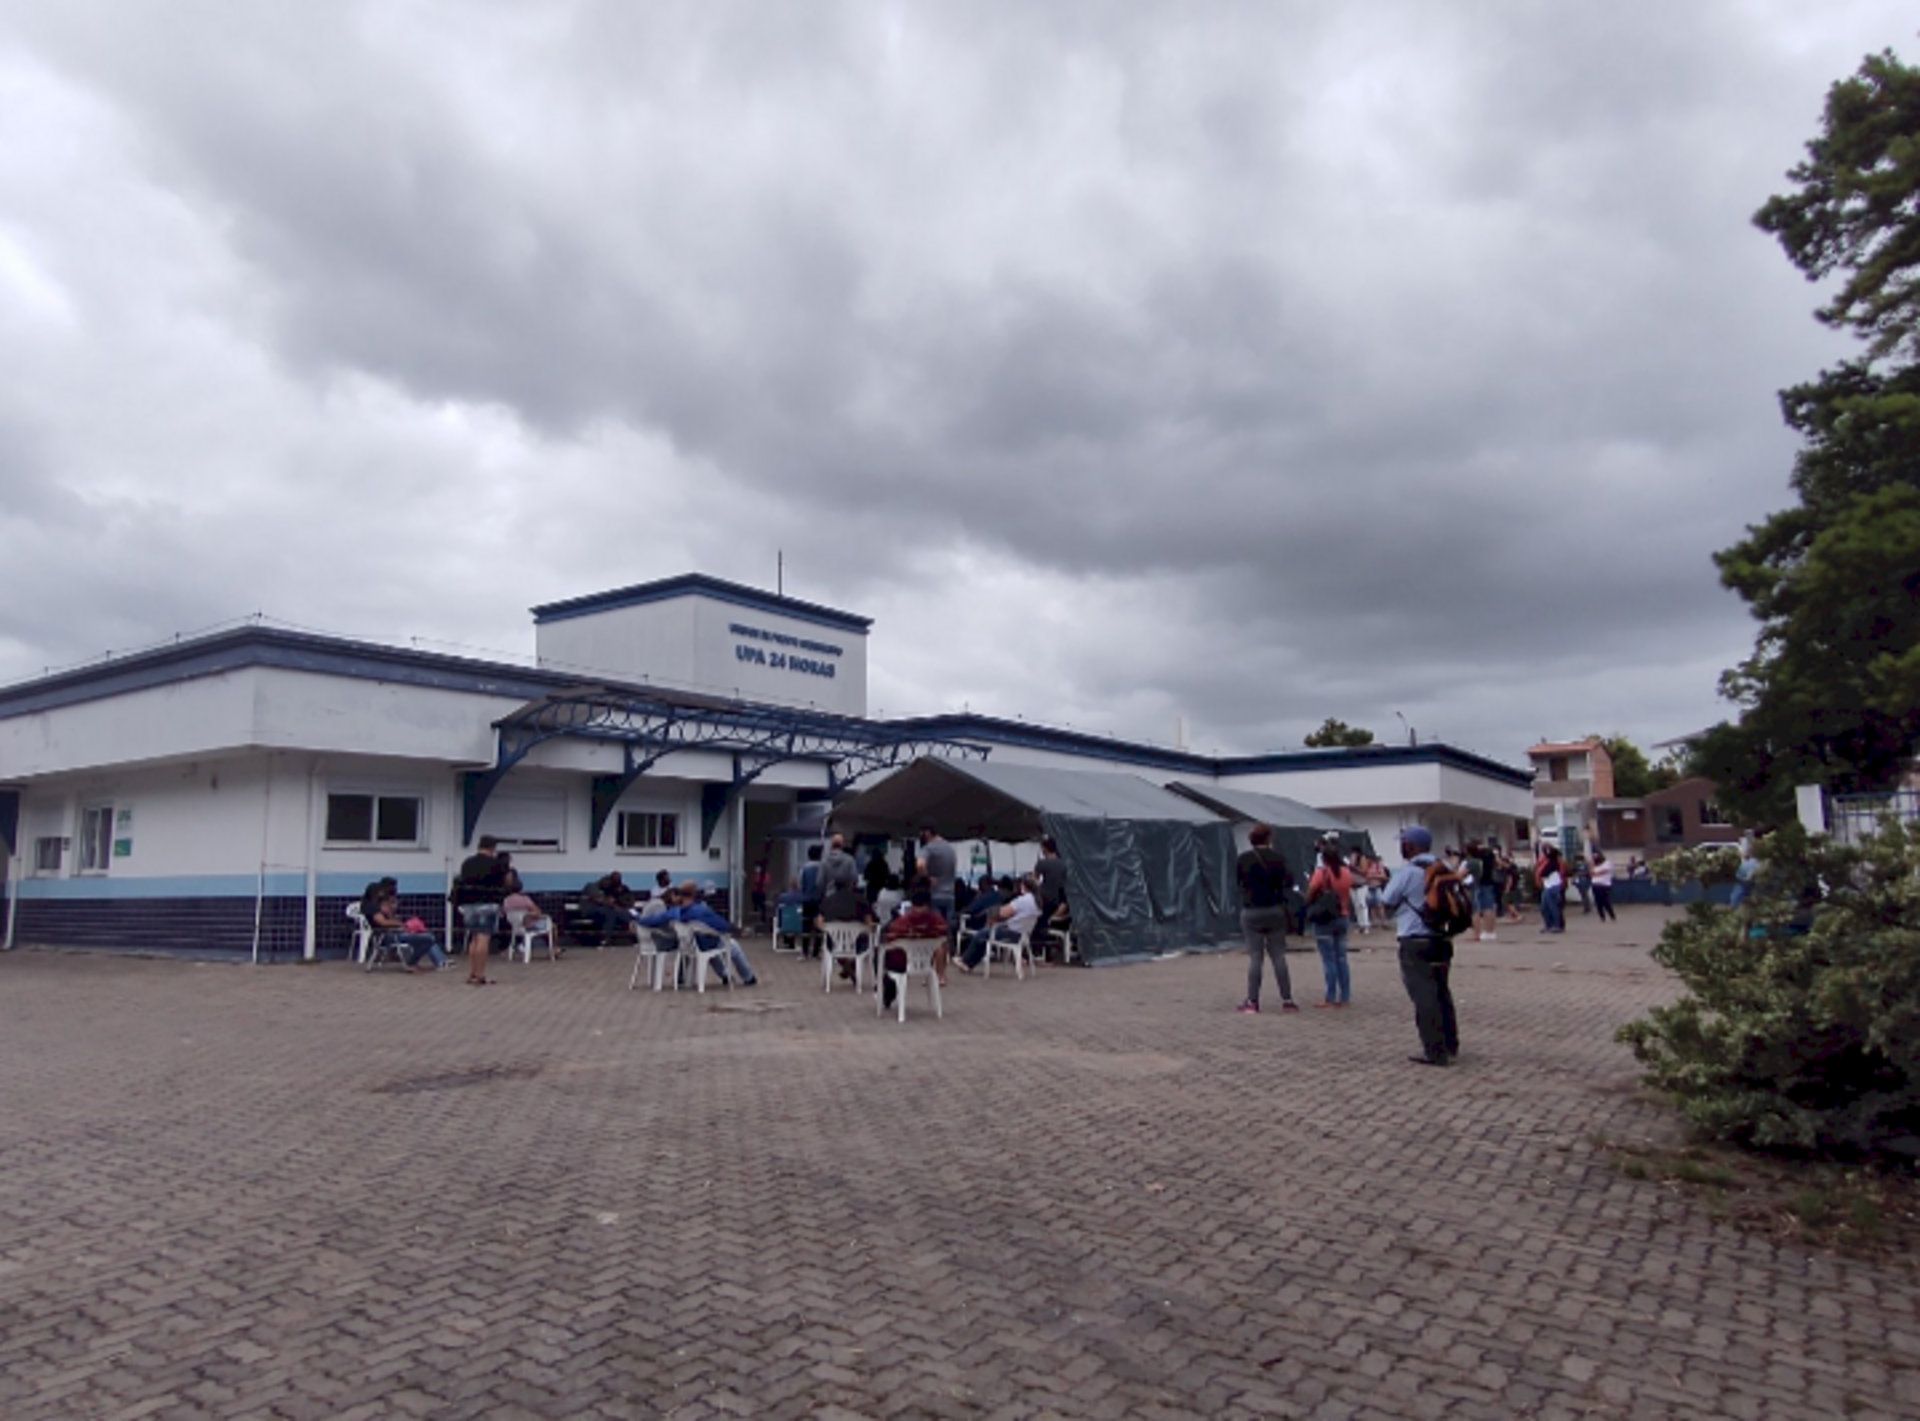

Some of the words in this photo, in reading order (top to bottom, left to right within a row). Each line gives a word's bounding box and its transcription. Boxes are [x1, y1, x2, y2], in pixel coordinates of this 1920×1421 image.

[736, 645, 766, 665] UPA
[769, 652, 786, 669] 24
[789, 655, 836, 678] HORAS
